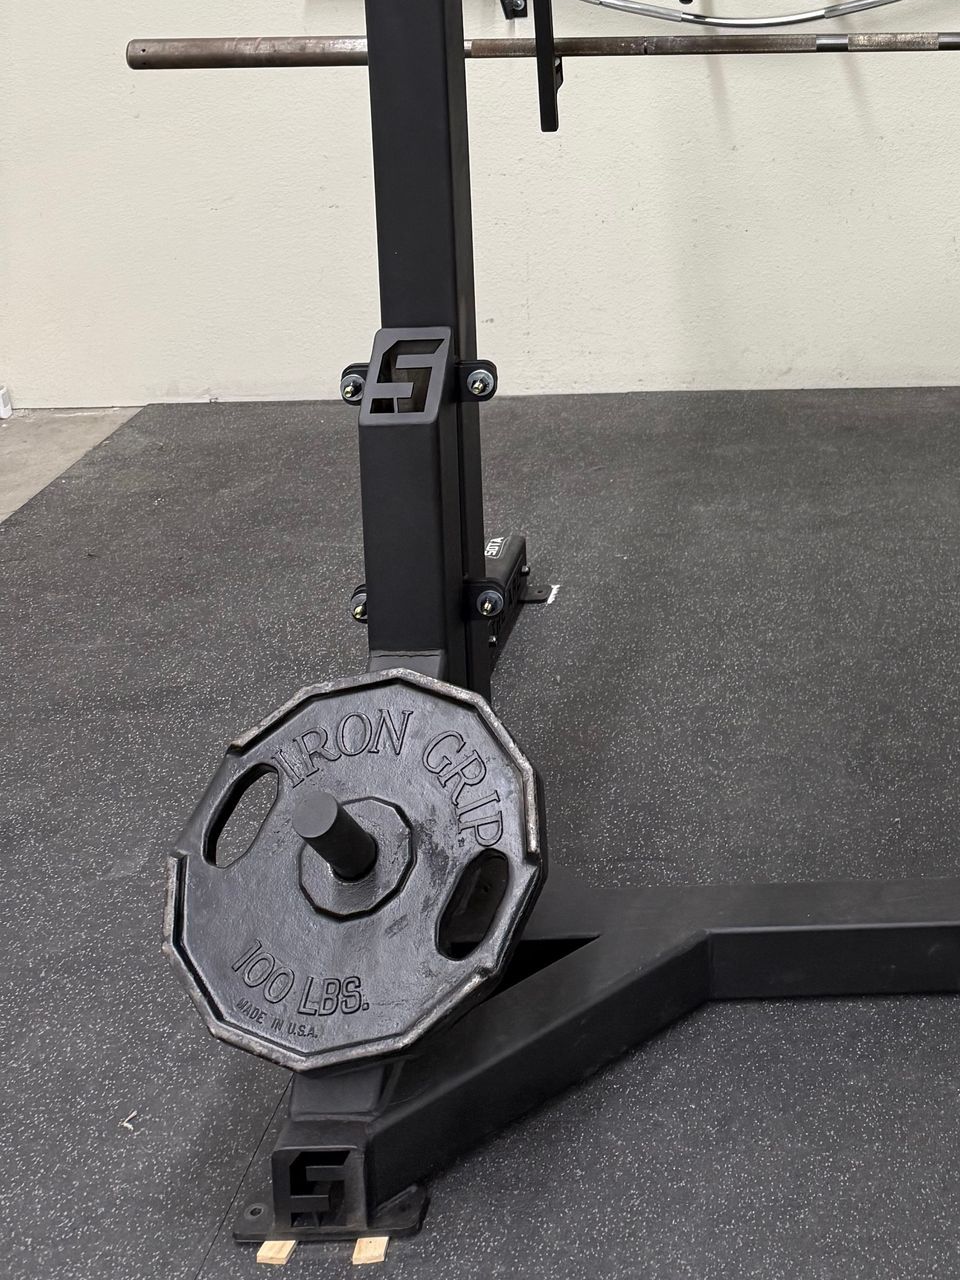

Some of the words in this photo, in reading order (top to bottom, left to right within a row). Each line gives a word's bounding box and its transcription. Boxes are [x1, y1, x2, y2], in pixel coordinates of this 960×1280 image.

[272, 708, 414, 789] IRON
[422, 730, 505, 848] GRIP
[231, 937, 296, 1005] 100
[297, 975, 371, 1017] LBS.
[236, 997, 269, 1026] MADE
[270, 1018, 284, 1033] IN
[286, 1021, 319, 1039] U.S.A.
